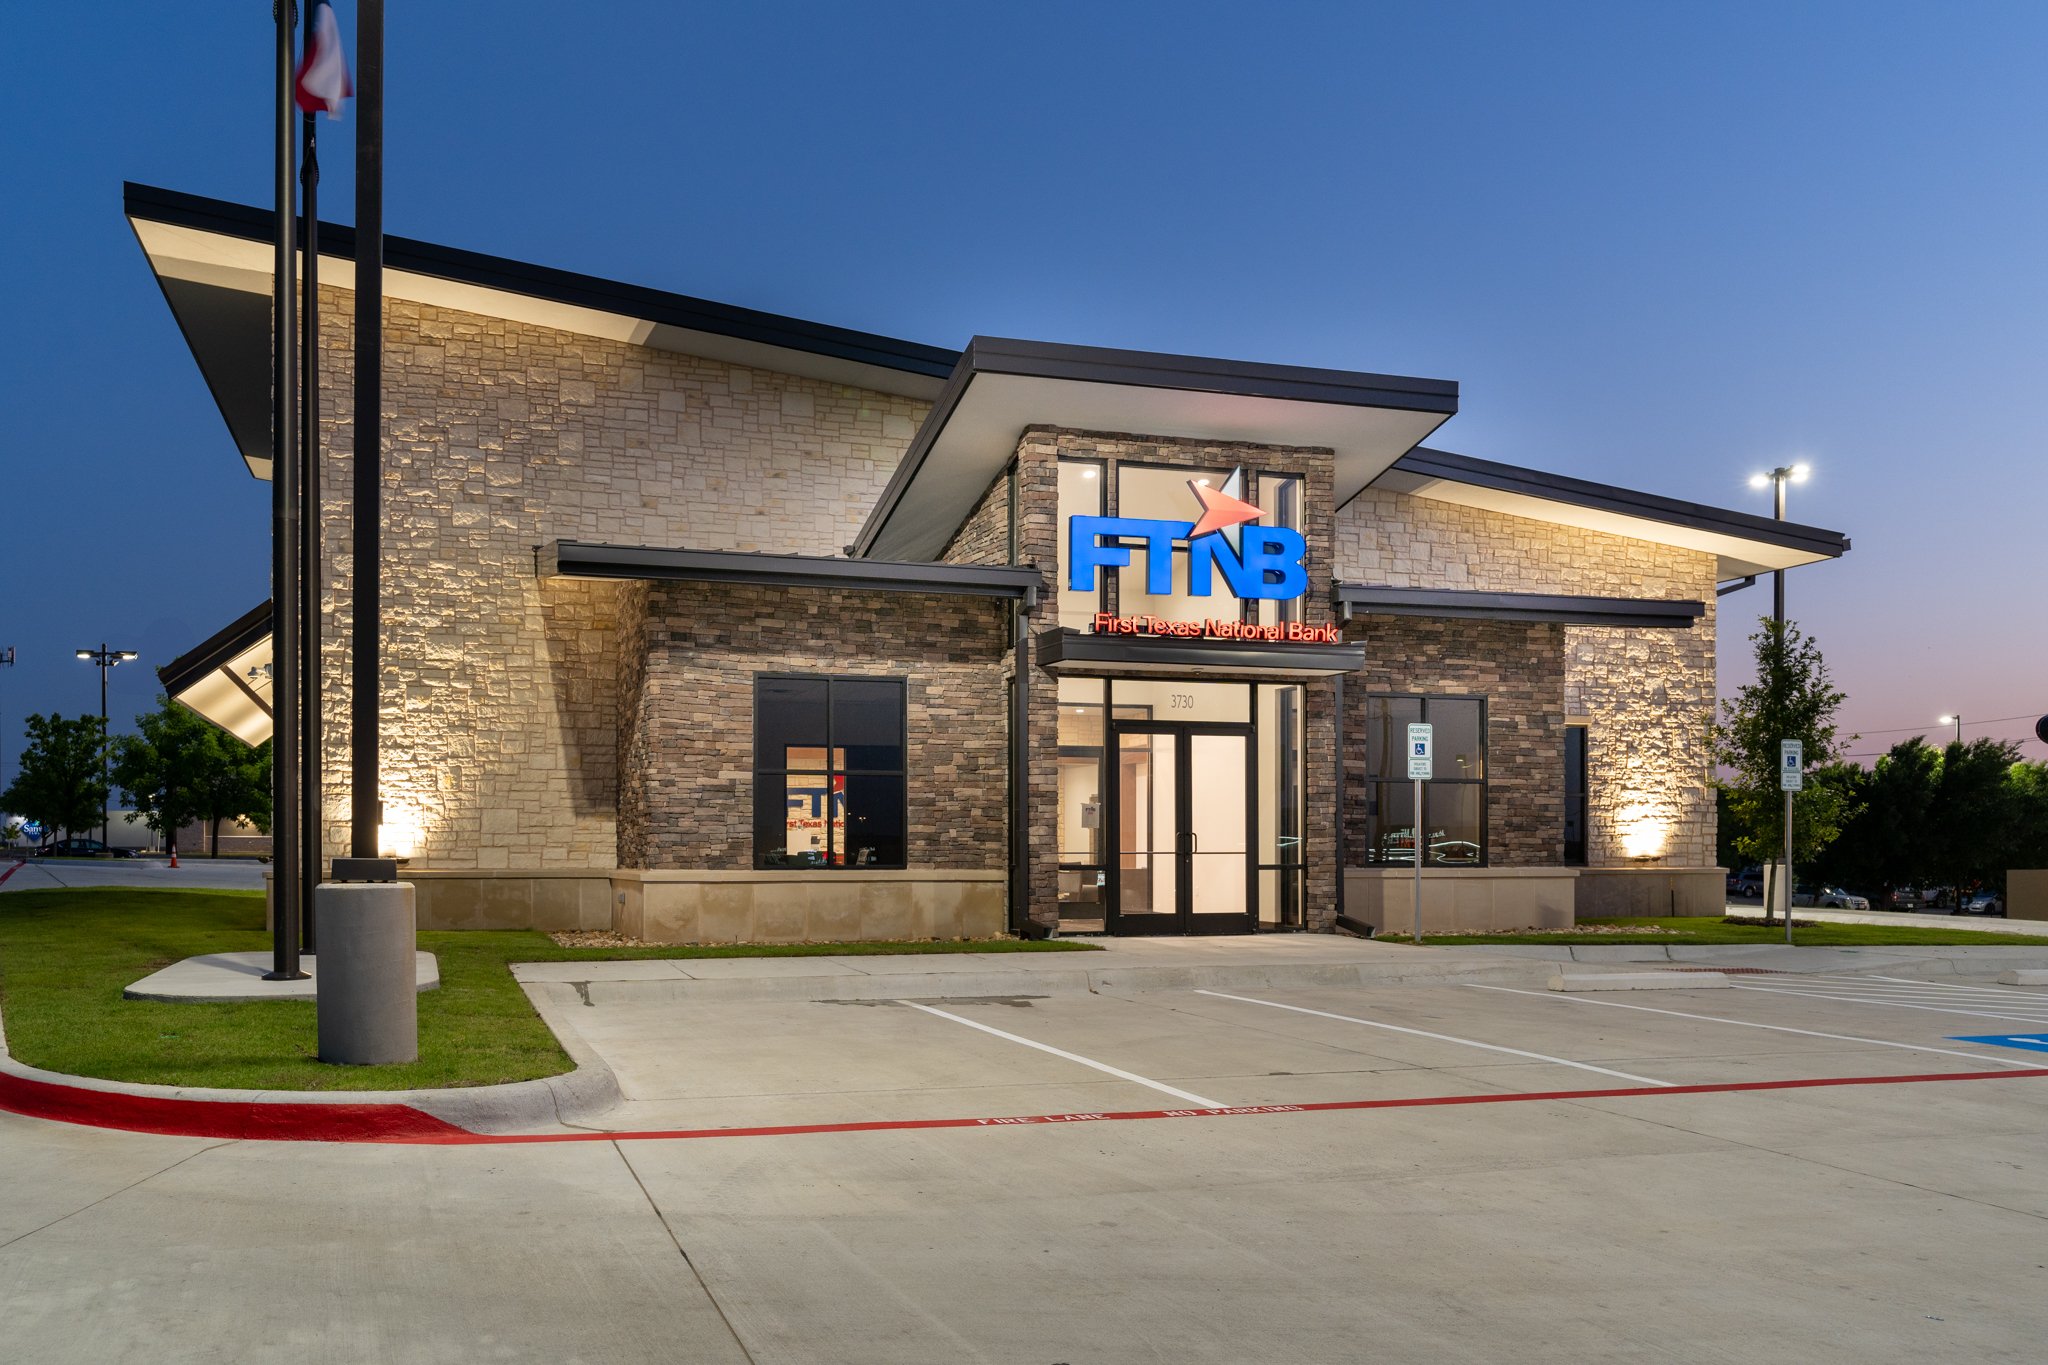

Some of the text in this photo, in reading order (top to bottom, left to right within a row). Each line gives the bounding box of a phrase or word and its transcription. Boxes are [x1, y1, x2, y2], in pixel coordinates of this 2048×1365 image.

[1068, 515, 1308, 600] FTNB
[1094, 611, 1339, 643] First Texas National Bank
[1171, 695, 1193, 708] 3730
[977, 1117, 1035, 1125] FIRE
[1044, 1113, 1110, 1121] LANE
[1206, 1105, 1304, 1115] PARKING
